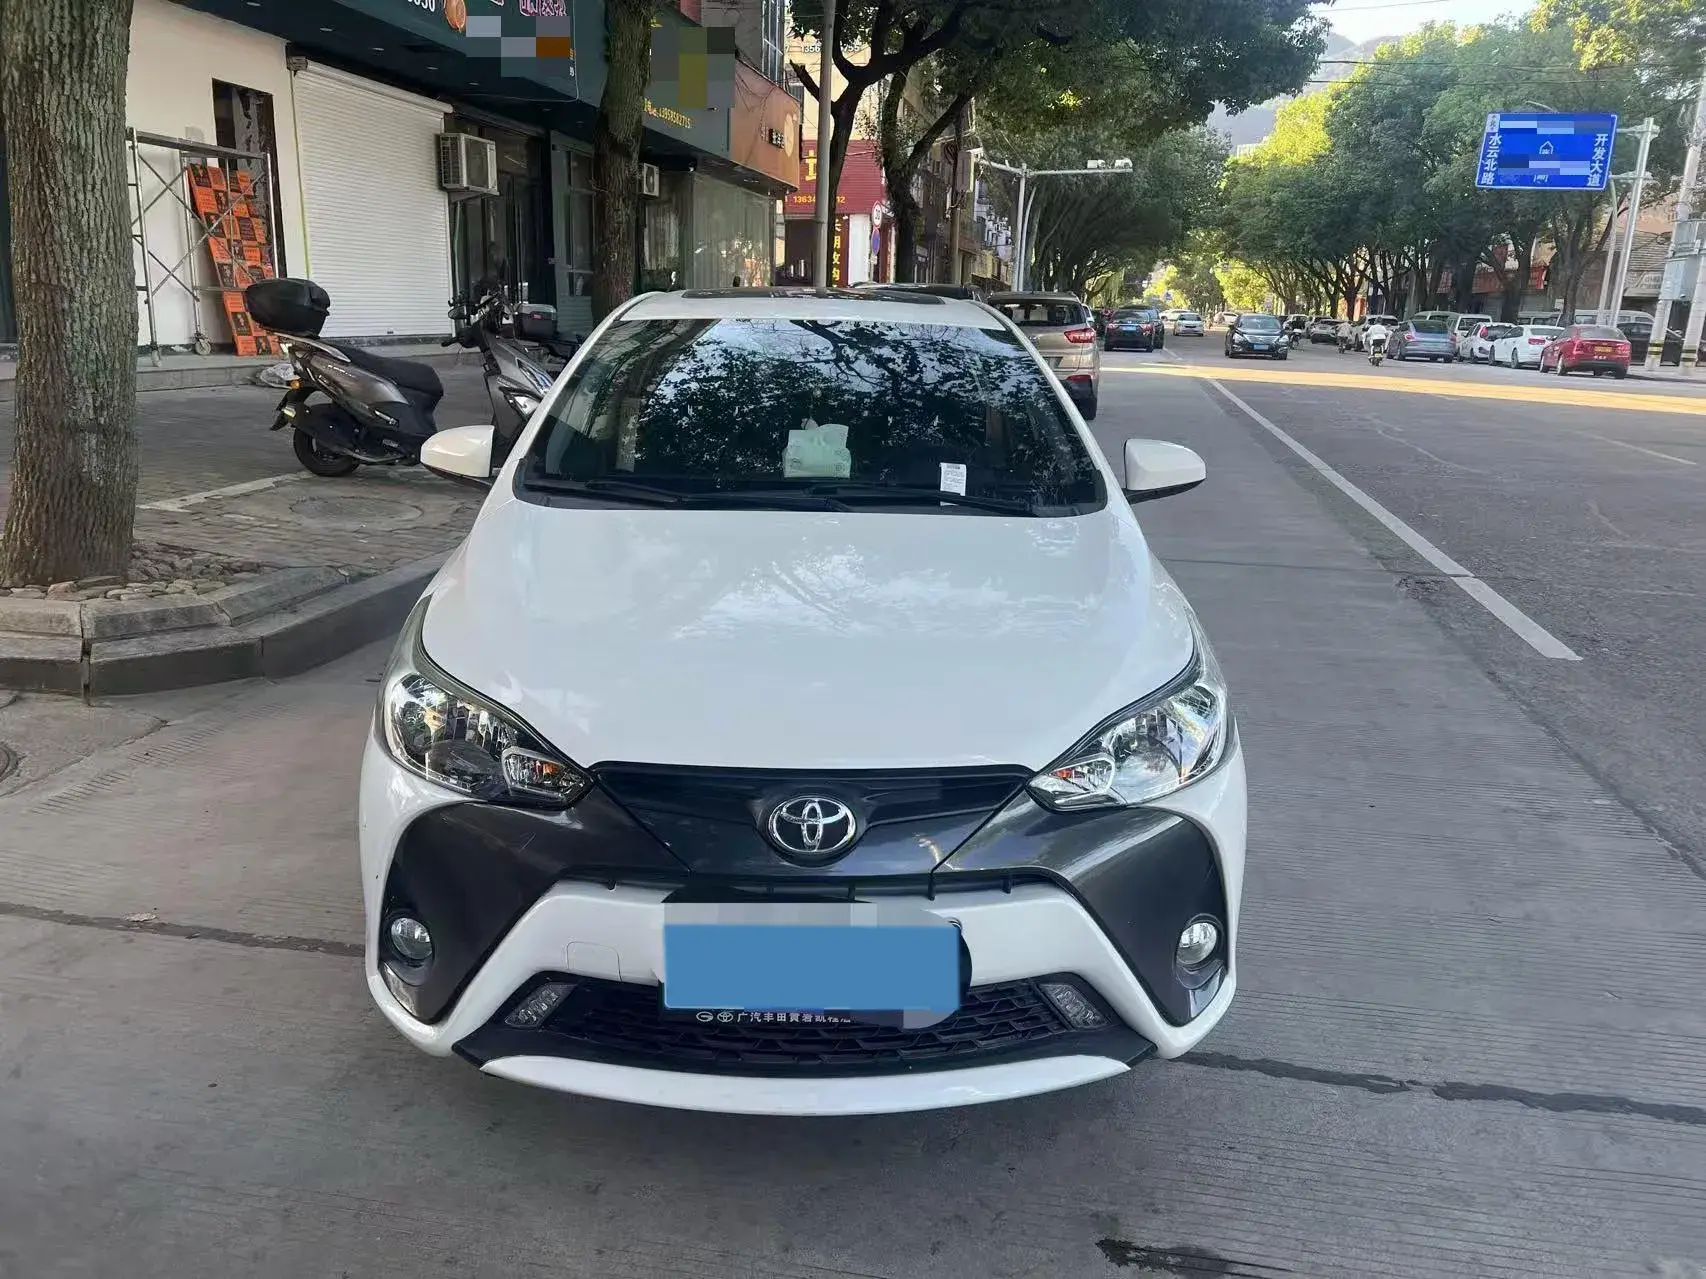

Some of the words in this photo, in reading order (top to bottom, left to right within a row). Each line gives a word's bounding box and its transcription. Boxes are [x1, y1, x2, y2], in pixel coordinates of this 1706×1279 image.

[1480, 133, 1502, 185] 水云北路
[1587, 133, 1608, 186] 开发大道
